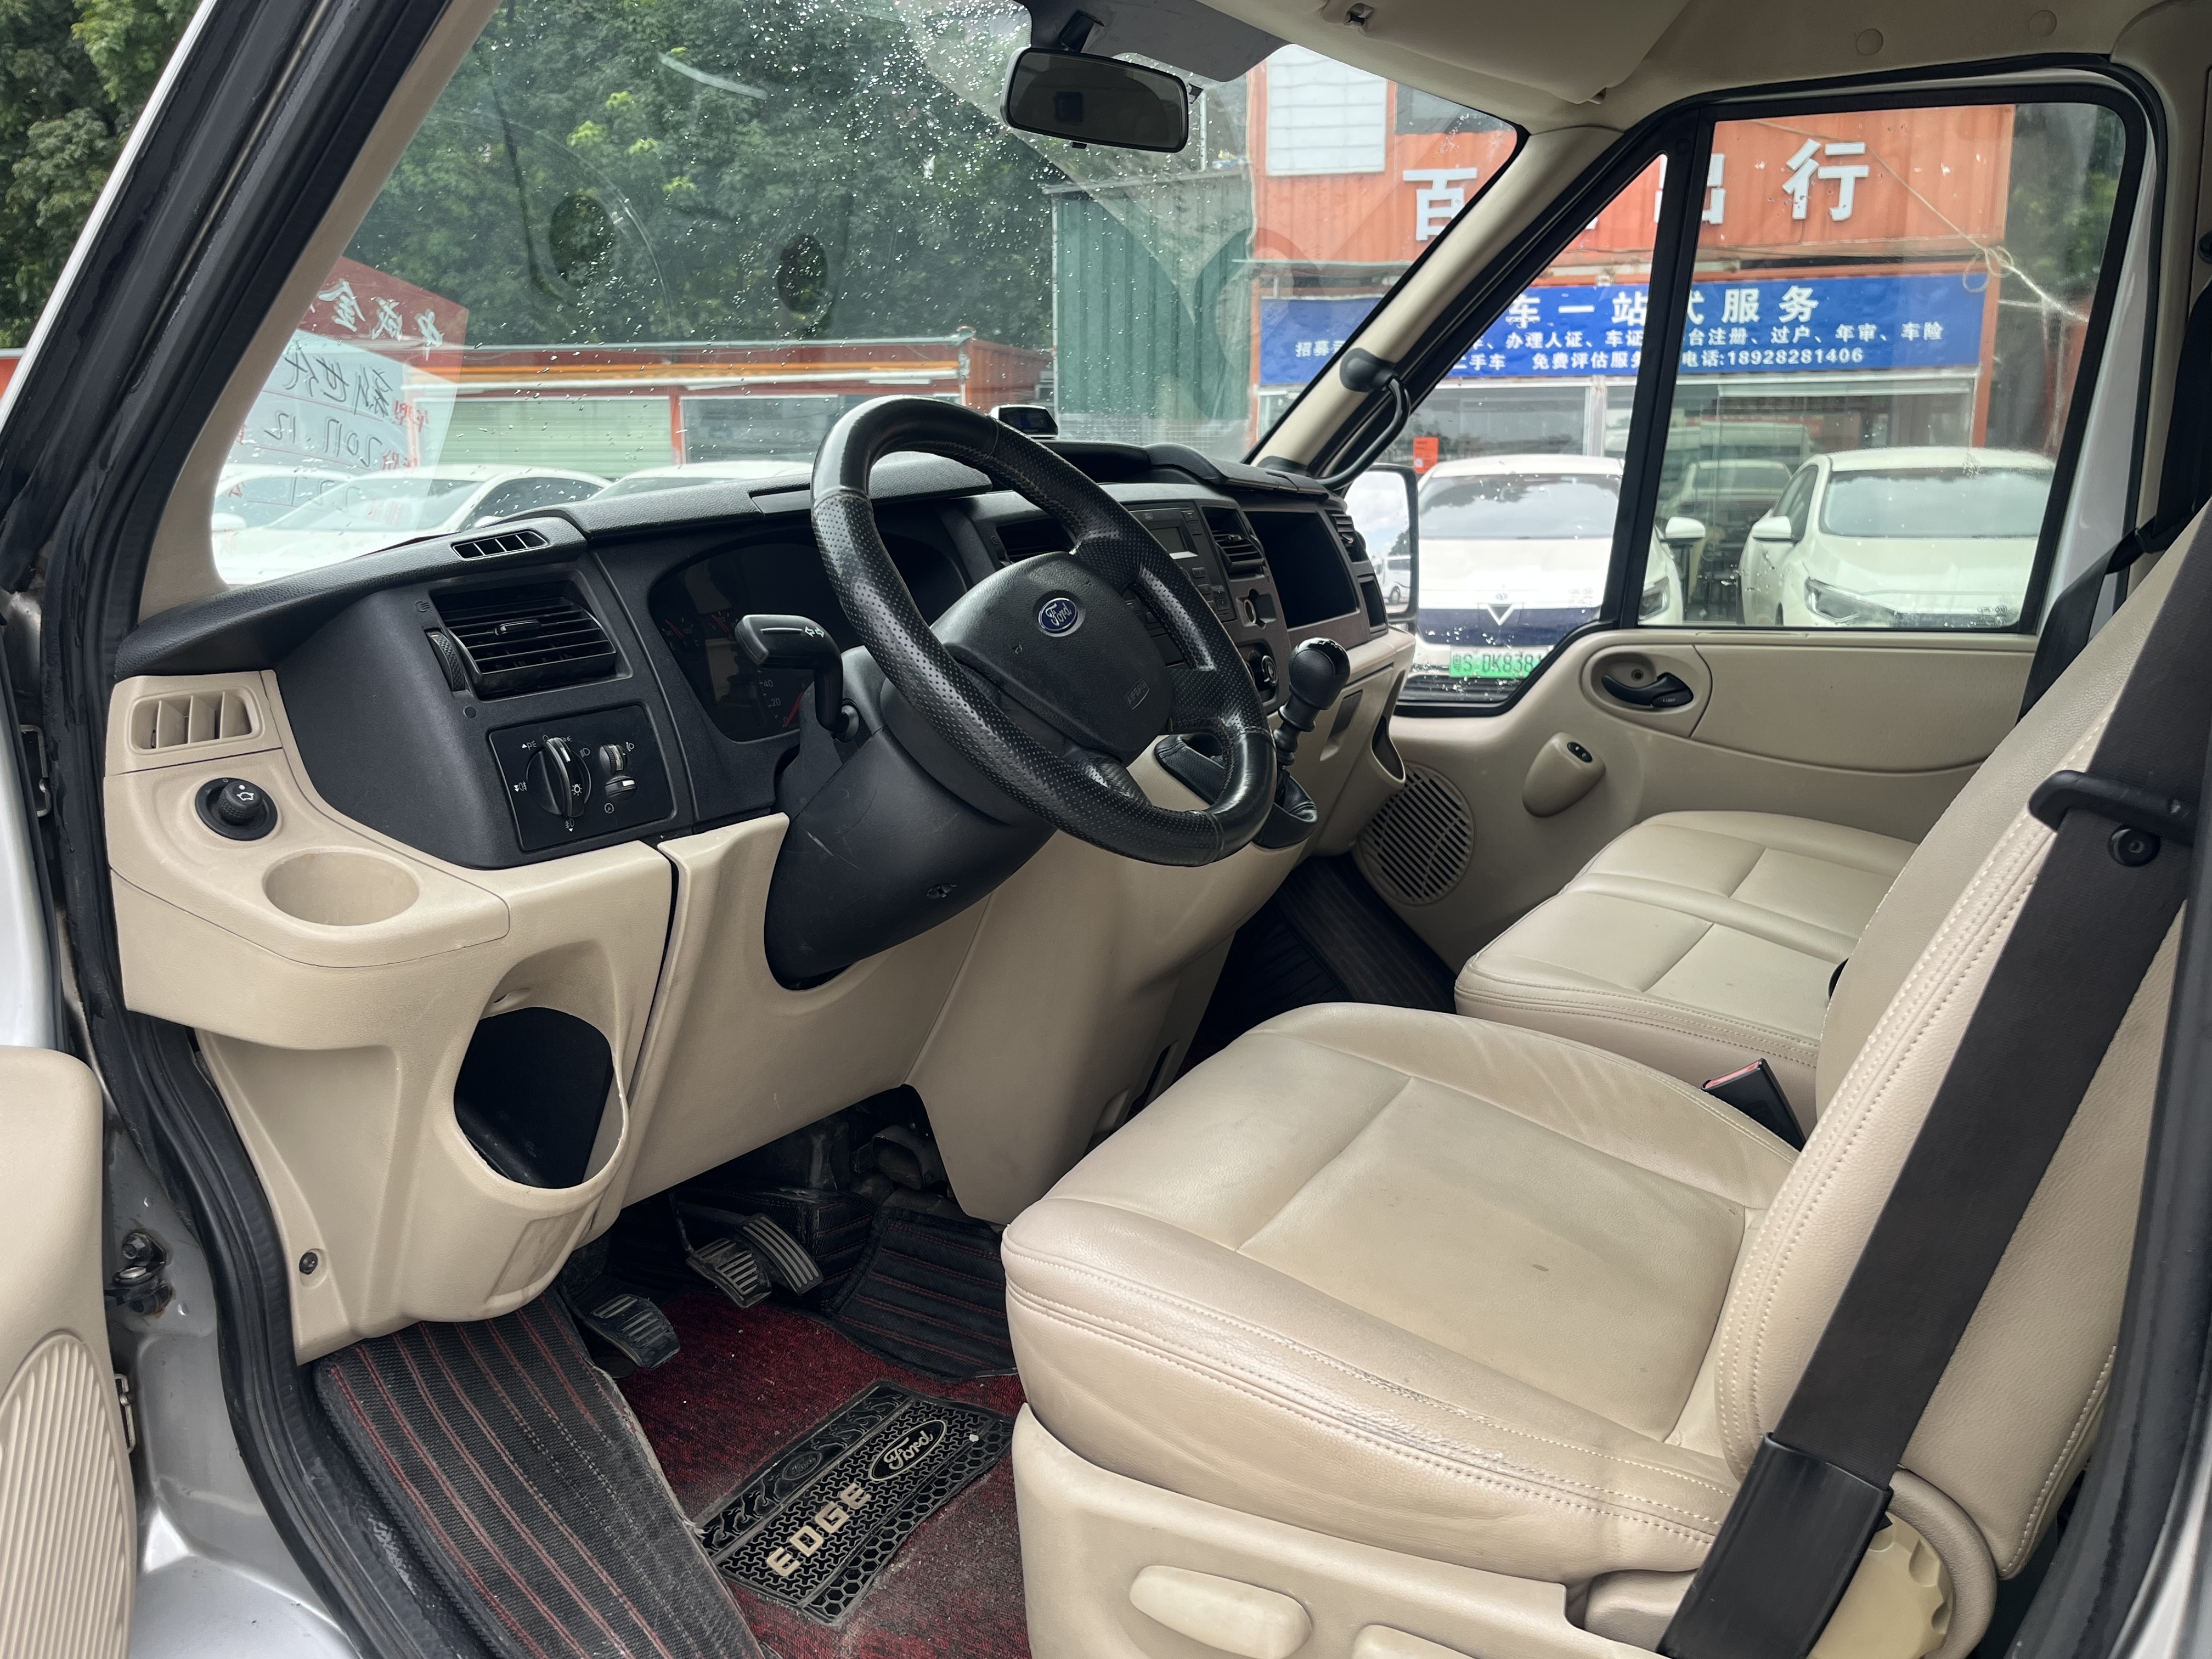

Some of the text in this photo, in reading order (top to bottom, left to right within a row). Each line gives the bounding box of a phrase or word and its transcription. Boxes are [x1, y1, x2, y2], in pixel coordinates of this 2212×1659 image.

[1402, 167, 1478, 241] 百
[1045, 601, 1073, 627] Ford
[763, 679, 774, 688] 40
[770, 697, 782, 707] 20
[883, 1430, 933, 1470] Ford
[766, 1481, 871, 1577] EDGE
